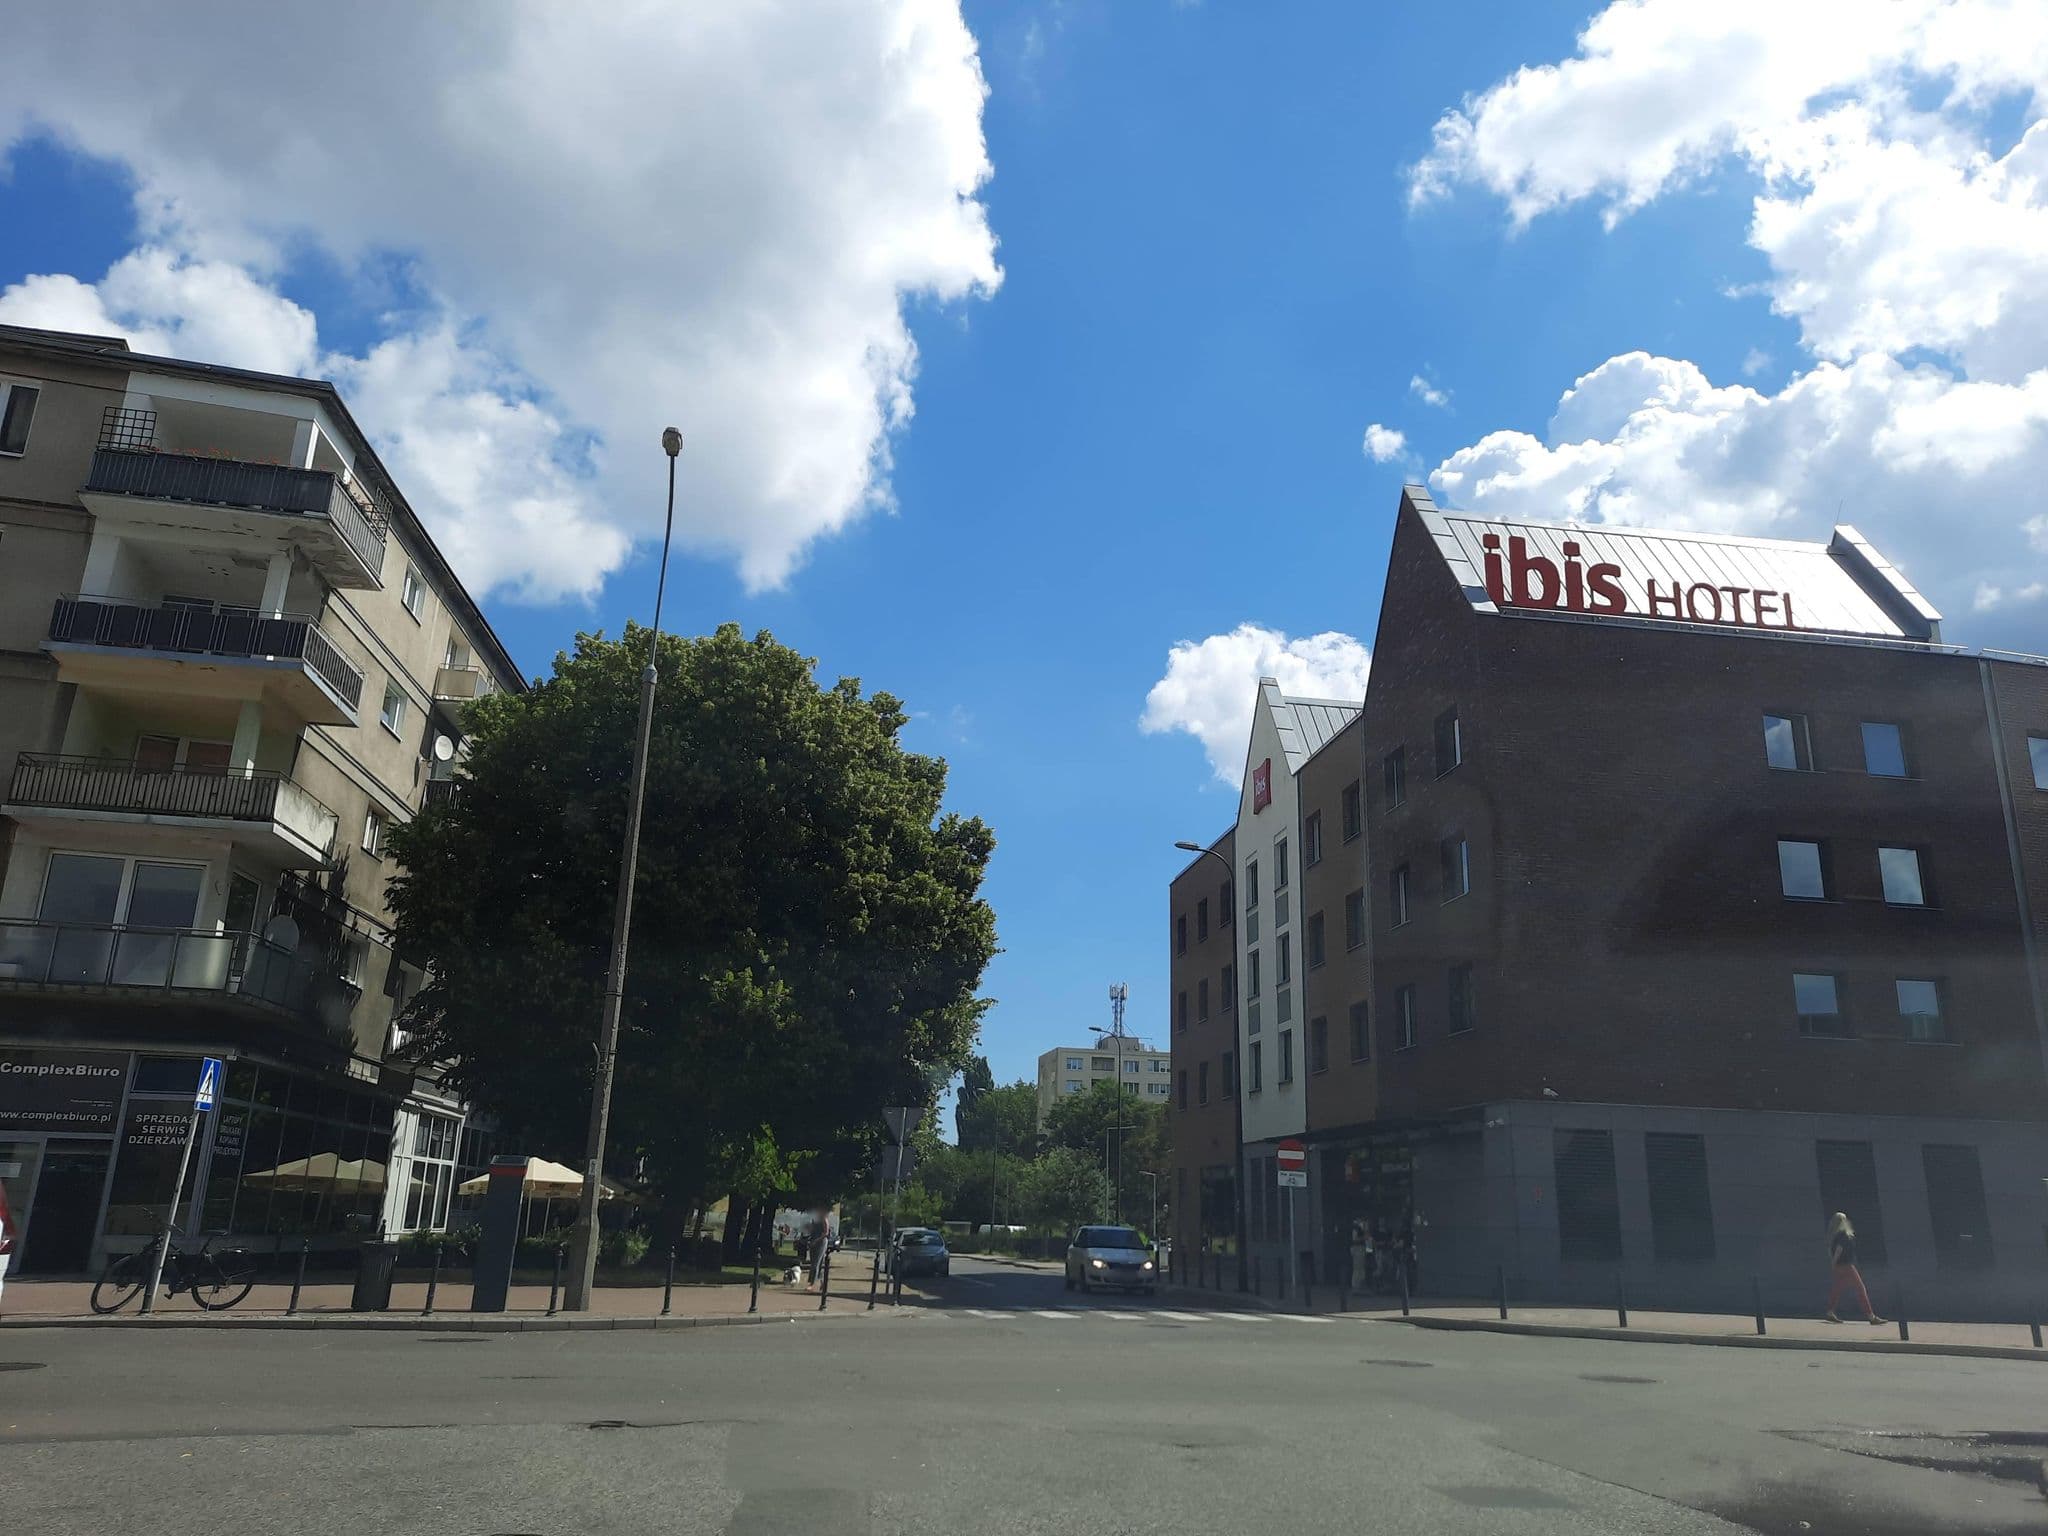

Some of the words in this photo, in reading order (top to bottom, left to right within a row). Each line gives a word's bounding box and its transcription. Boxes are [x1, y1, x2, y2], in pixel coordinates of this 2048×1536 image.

[1482, 533, 1627, 615] ibis
[1646, 578, 1807, 631] HOTEL
[0, 1062, 120, 1077] ComplexBiuro
[141, 1125, 186, 1135] SERWIS
